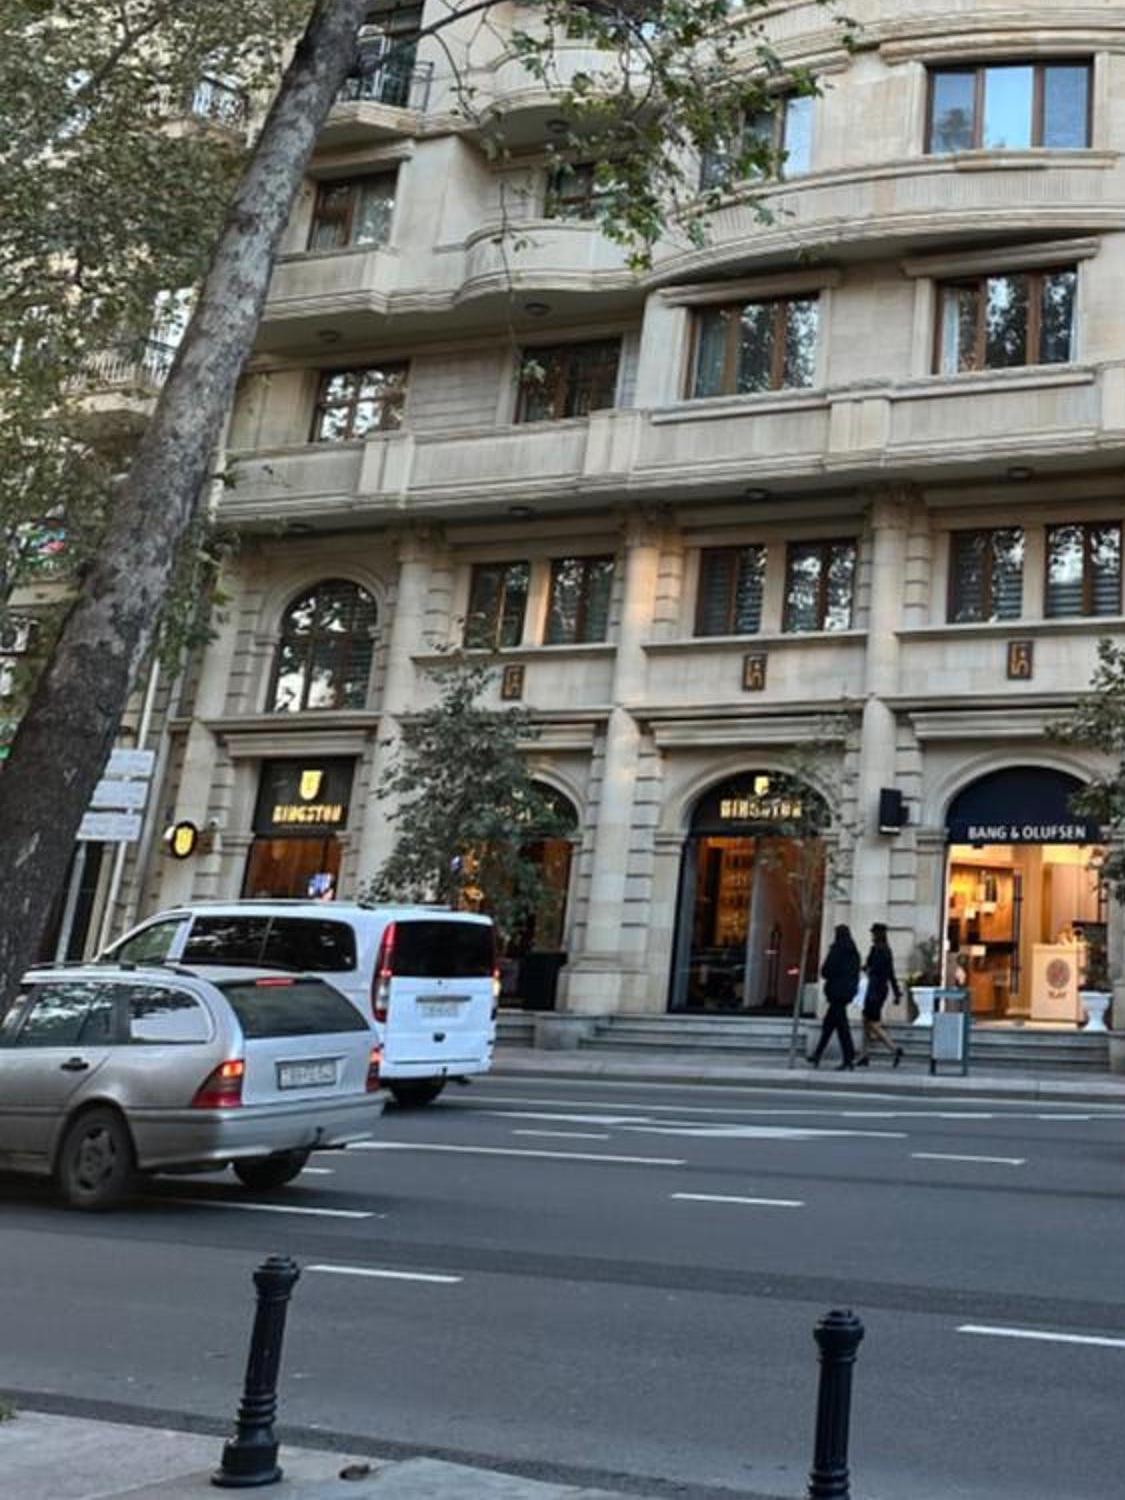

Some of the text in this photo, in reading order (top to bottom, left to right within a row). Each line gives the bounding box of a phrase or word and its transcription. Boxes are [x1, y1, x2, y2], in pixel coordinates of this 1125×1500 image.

[968, 824, 1086, 839] BANG & OLUFSEN
